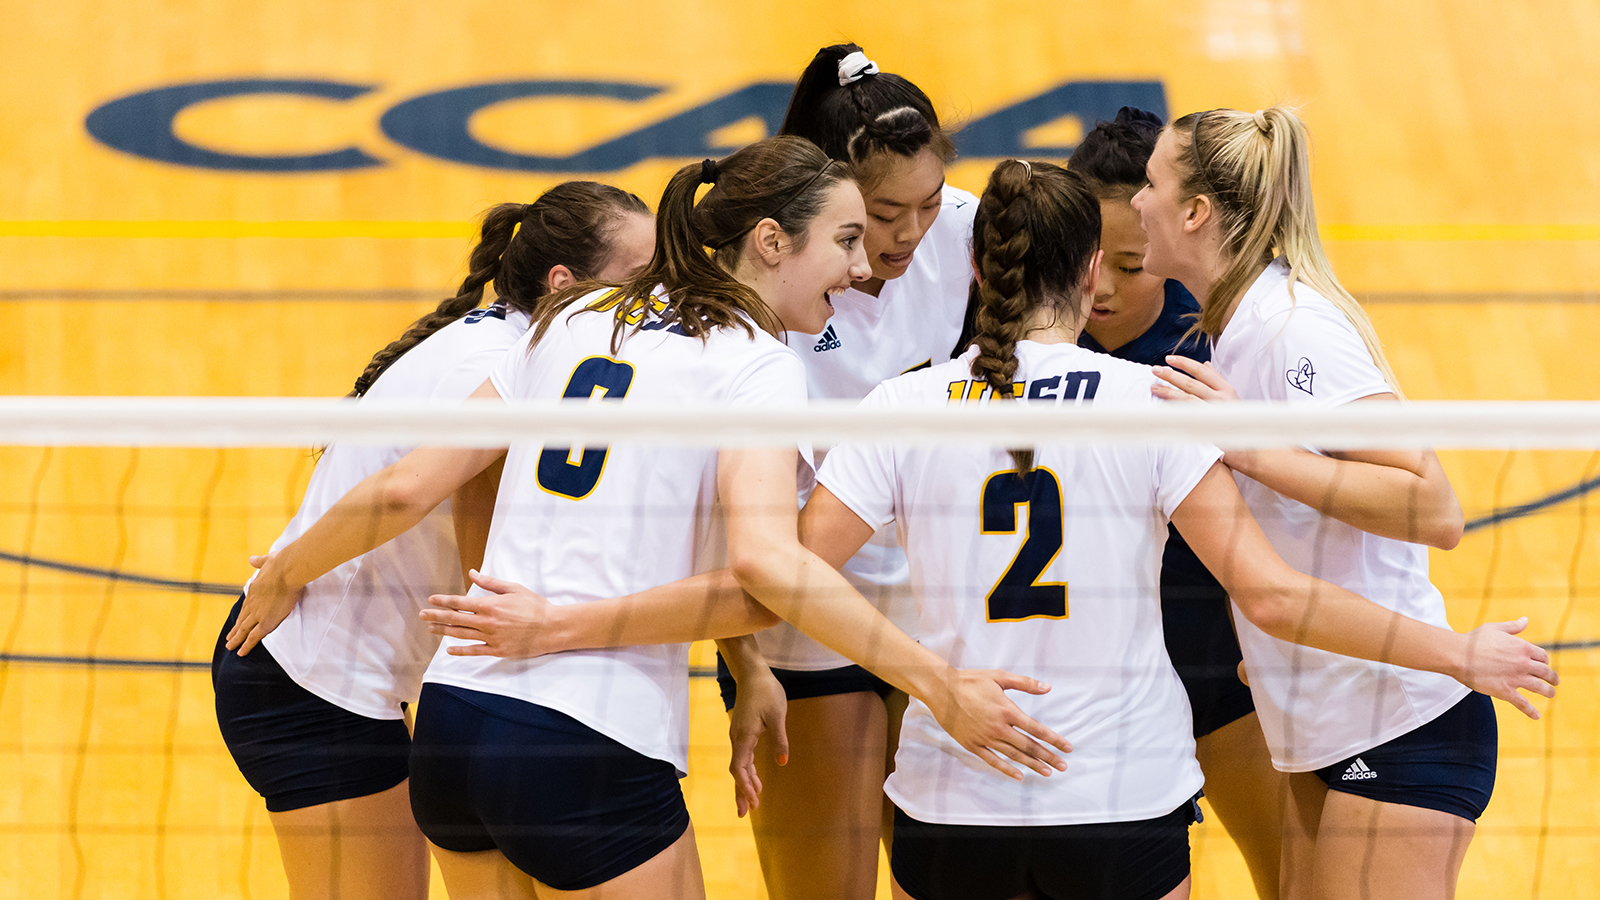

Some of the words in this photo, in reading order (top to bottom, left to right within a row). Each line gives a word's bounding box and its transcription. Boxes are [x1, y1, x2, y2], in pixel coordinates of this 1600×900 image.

[85, 78, 1168, 172] CCAA
[979, 465, 1069, 623] 2
[1342, 771, 1378, 780] adidas
